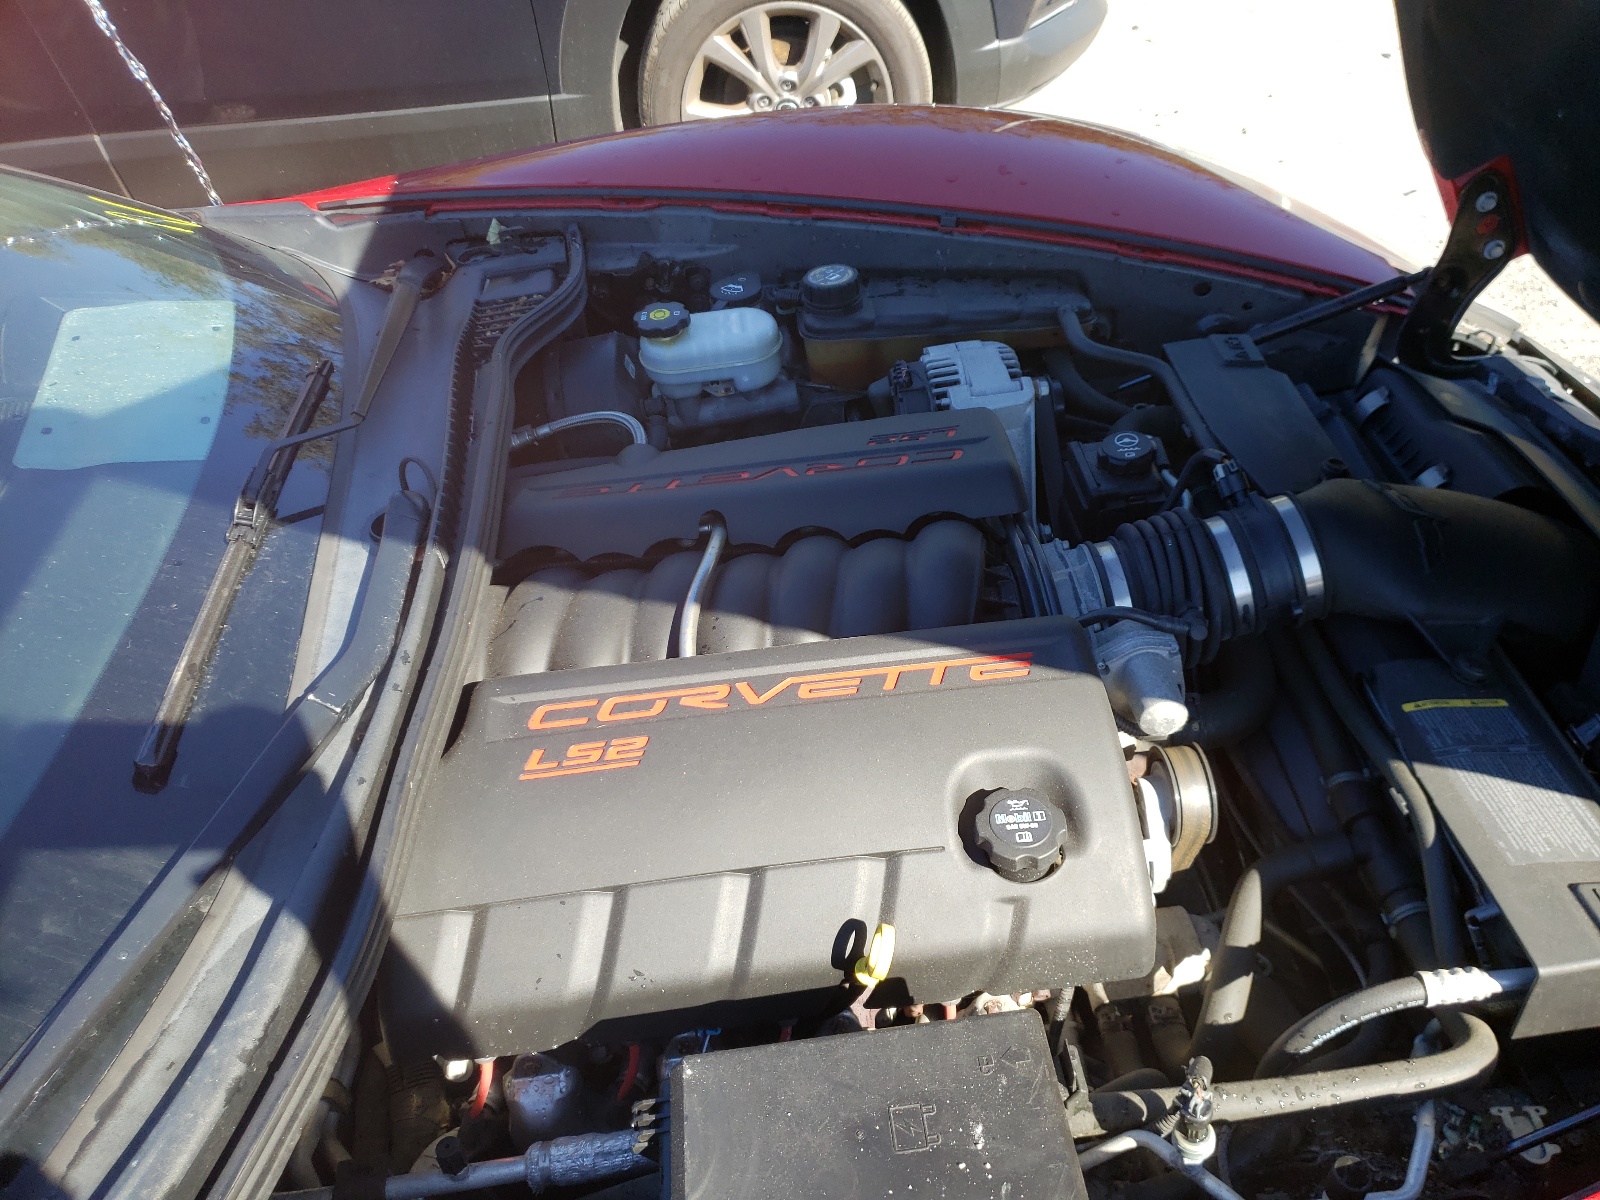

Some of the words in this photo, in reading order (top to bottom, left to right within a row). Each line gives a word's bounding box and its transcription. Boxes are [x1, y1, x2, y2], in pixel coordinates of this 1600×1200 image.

[552, 449, 964, 500] CORVETTE
[527, 652, 1034, 730] CORVETTE
[522, 736, 650, 775] LS2
[994, 812, 1032, 824] Mobil
